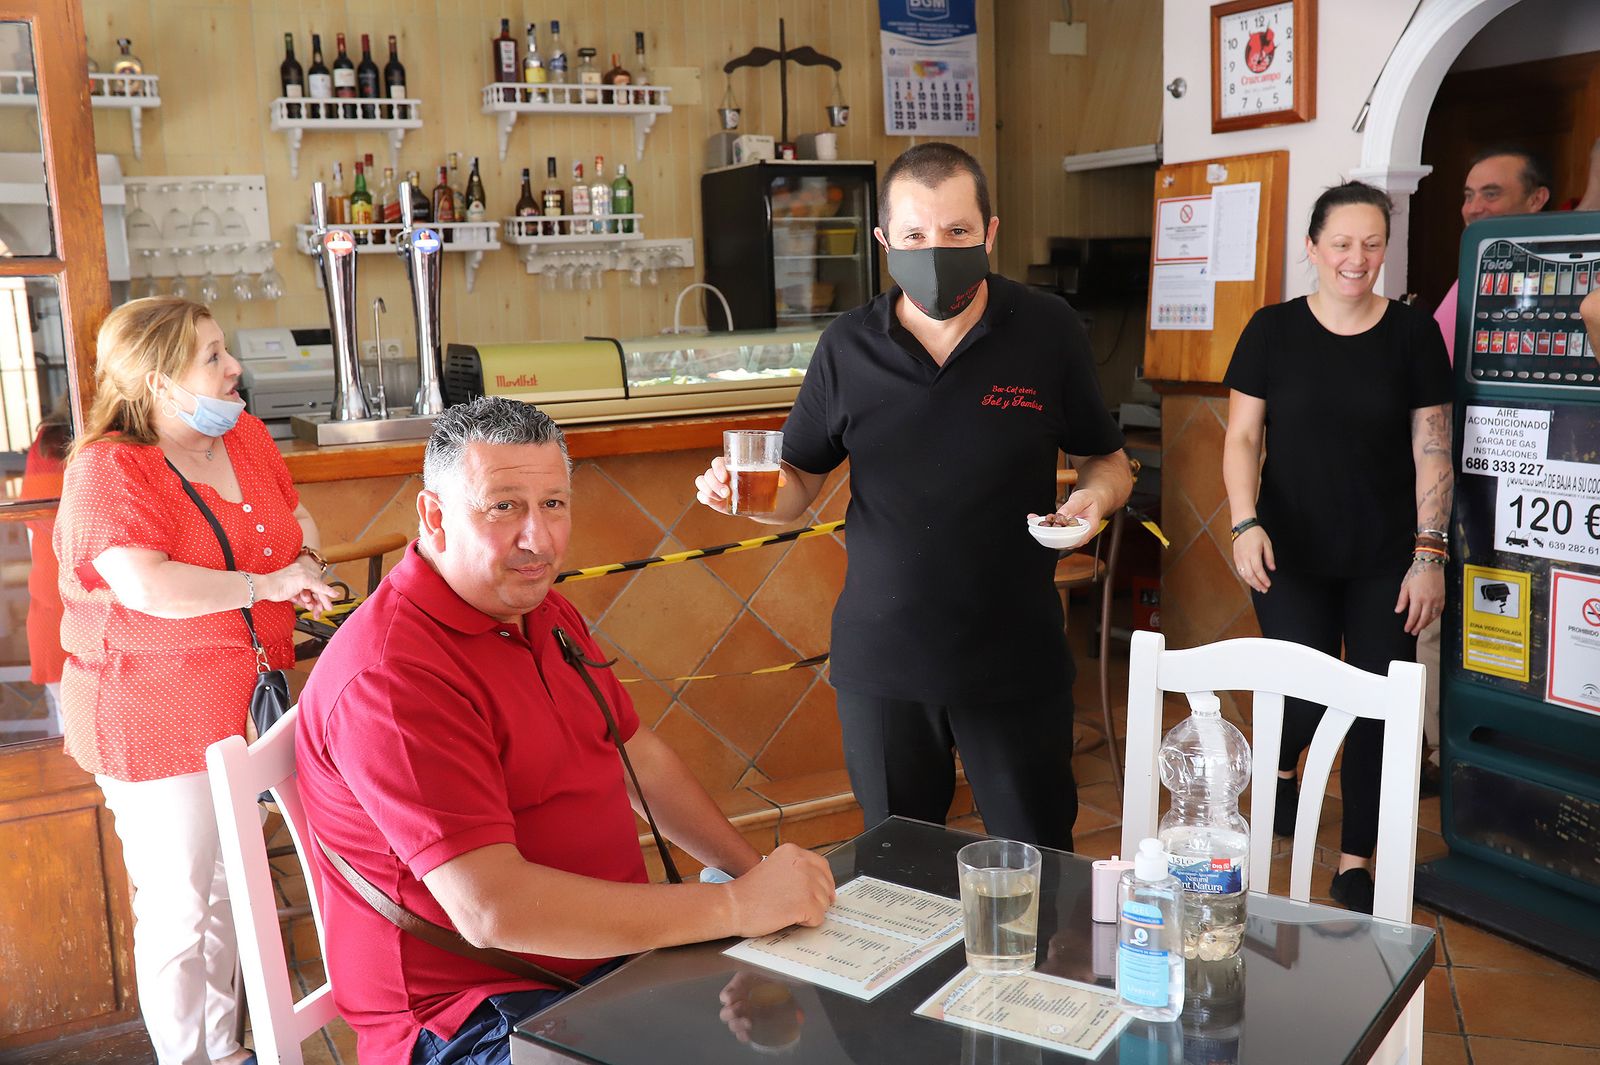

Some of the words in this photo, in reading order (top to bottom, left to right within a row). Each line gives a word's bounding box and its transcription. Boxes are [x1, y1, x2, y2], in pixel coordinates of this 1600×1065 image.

[1254, 15, 1265, 28] 12
[1274, 13, 1279, 24] 1
[1240, 20, 1248, 31] 11
[1286, 27, 1292, 39] 2
[1228, 38, 1238, 50] 10
[1286, 51, 1293, 63] 3
[1229, 61, 1235, 73] 9
[1285, 75, 1292, 85] 4
[1229, 83, 1236, 95] 8
[1242, 97, 1248, 109] 7
[1256, 97, 1262, 109] 6
[1273, 92, 1279, 104] 5
[1497, 409, 1519, 418] AIRE
[1468, 416, 1548, 430] ACONDICIONADO
[1489, 428, 1524, 437] AVERIAS
[1476, 436, 1504, 446] CARGA
[1506, 439, 1517, 448] DE
[1519, 440, 1536, 449] GAS
[1473, 447, 1538, 459] INSTALACIONES
[1465, 457, 1489, 471] 686
[1492, 460, 1516, 473] 333
[1519, 462, 1544, 476] 227
[1556, 475, 1572, 490] BAJA
[1572, 476, 1577, 491] A
[1578, 477, 1587, 492] SU
[1509, 494, 1573, 535] 120
[1584, 503, 1600, 540] €
[1548, 541, 1566, 550] 639
[1568, 544, 1586, 553] 282
[1568, 625, 1600, 637] PROHIBIDO
[1192, 882, 1223, 891] Natura
